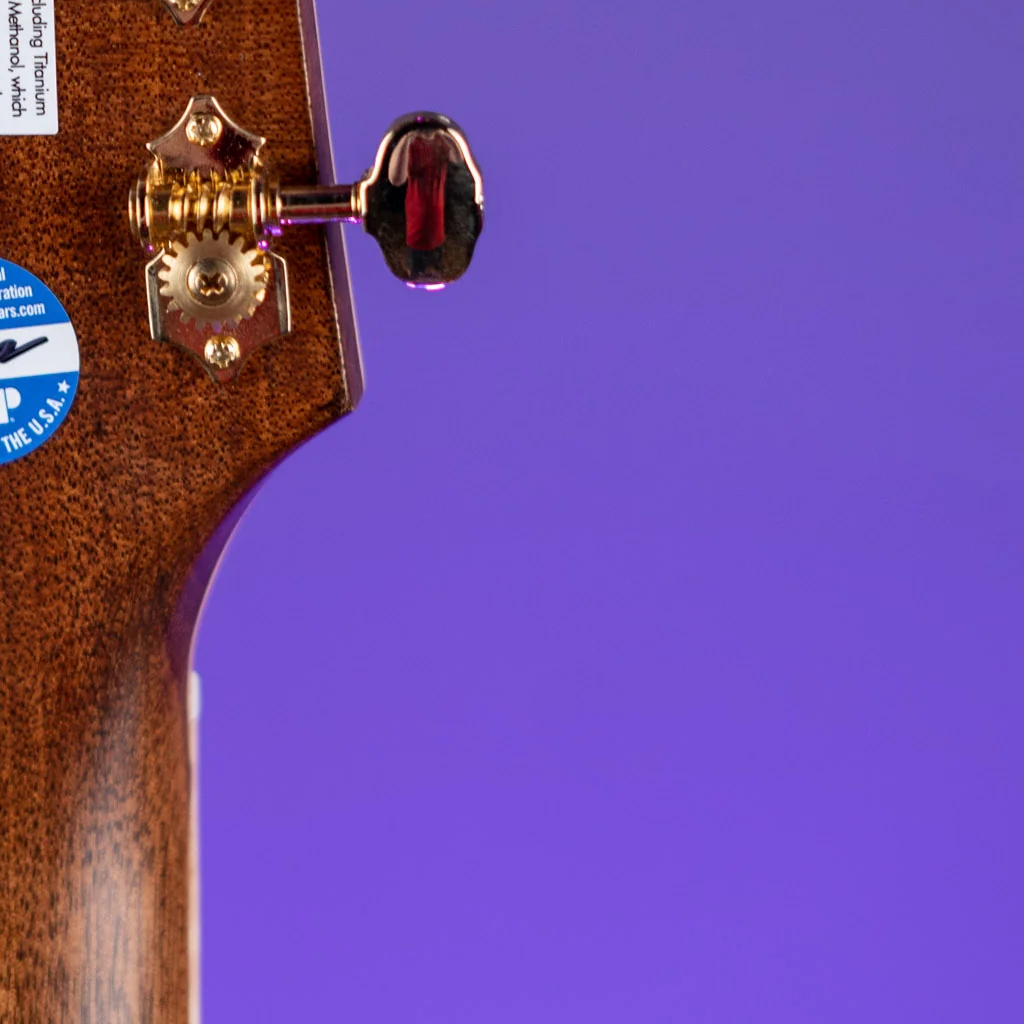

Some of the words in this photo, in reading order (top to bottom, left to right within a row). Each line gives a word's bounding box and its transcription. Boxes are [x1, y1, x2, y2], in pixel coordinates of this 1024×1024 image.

[8, 1, 25, 72] Methanol,
[11, 76, 27, 117] which
[34, 52, 49, 116] Titanium
[1, 428, 32, 453] THE
[29, 397, 65, 435] U.S.A.
